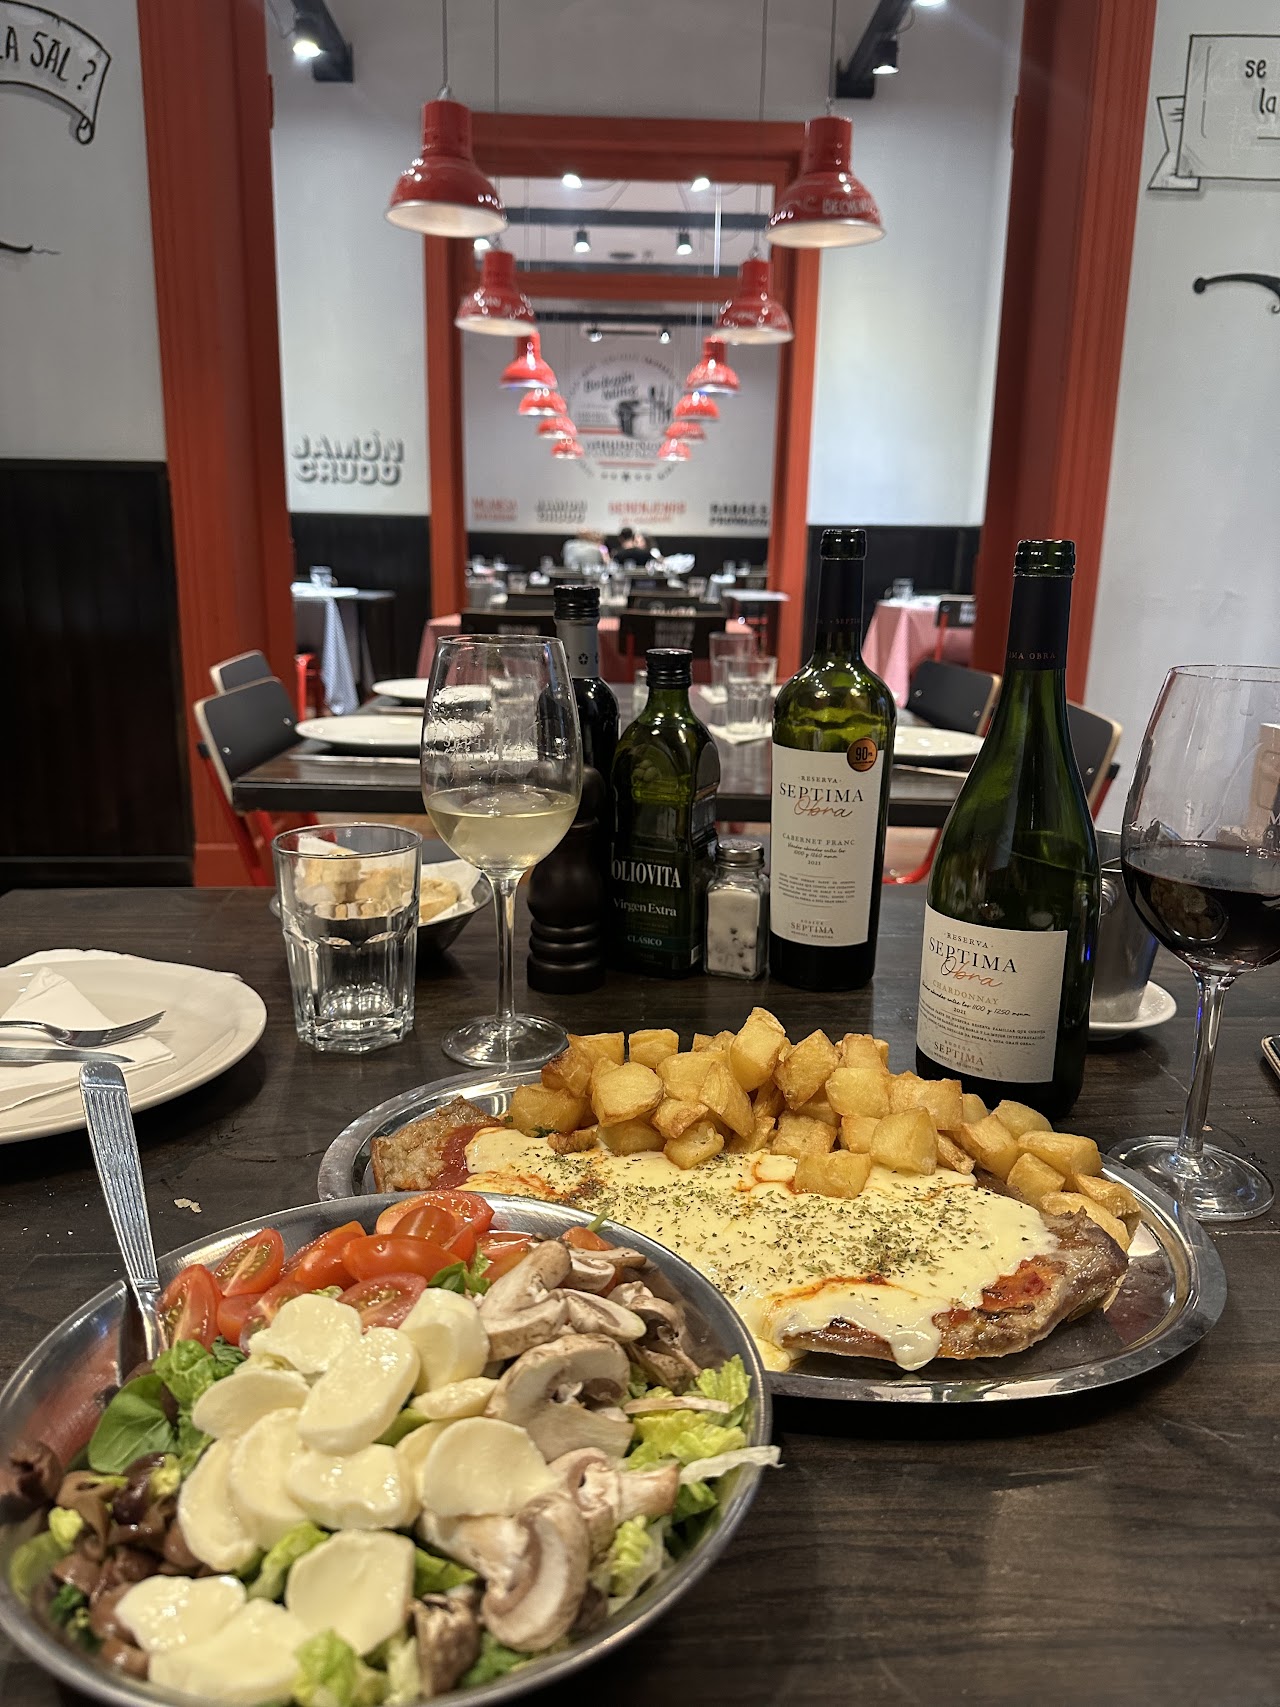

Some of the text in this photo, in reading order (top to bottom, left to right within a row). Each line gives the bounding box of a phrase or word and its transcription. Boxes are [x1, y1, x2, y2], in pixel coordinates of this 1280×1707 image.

[0, 25, 97, 90] A SAL ?
[1245, 59, 1267, 78] se
[1259, 87, 1277, 115] la
[294, 459, 401, 486] CRUDO
[1029, 652, 1056, 660] OBRA
[855, 746, 868, 761] 90
[779, 782, 864, 803] SEPTIMA
[794, 795, 853, 818] Obra
[782, 832, 822, 845] CABERNET
[611, 858, 682, 889] OLIOVITA
[613, 897, 677, 917] Virgen Extra
[790, 922, 834, 935] SEPTIMA
[946, 931, 989, 949] RESERVA
[928, 936, 1018, 974] SEPTIMA
[941, 956, 1003, 988] Obra
[932, 979, 1000, 1005] CHARDONNAY
[953, 1007, 967, 1015] 2021
[993, 1008, 1010, 1016] 1250
[933, 1041, 985, 1067] SEPTIMA
